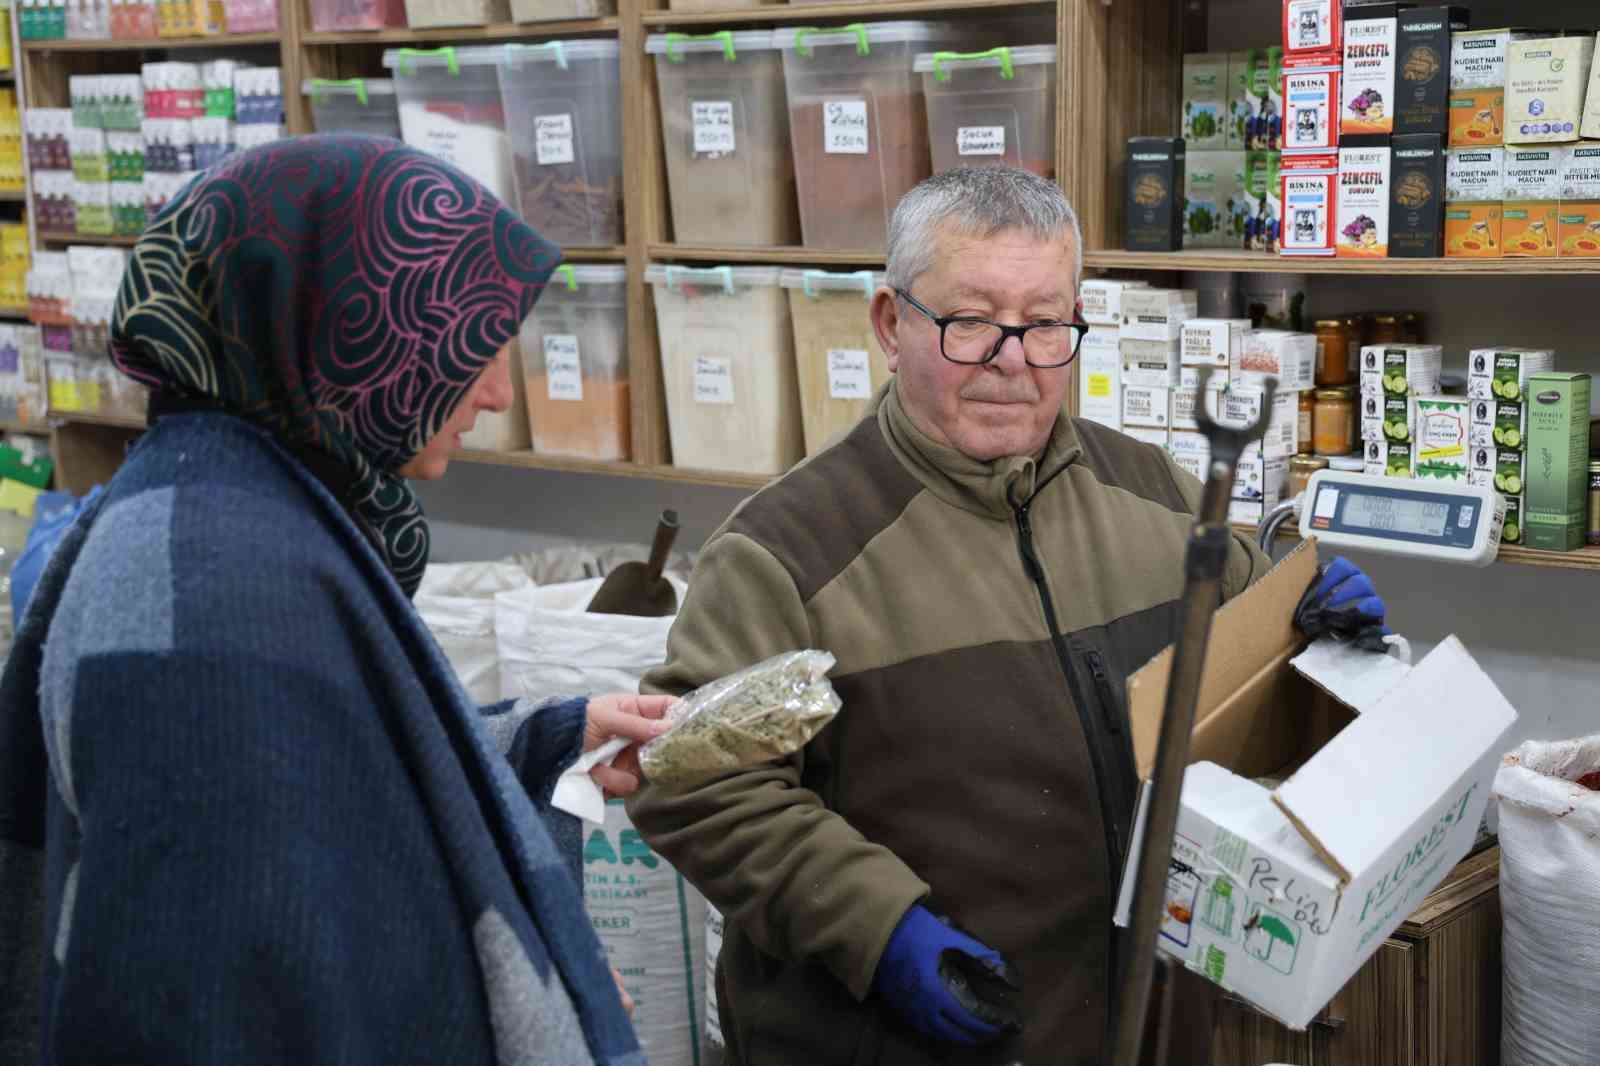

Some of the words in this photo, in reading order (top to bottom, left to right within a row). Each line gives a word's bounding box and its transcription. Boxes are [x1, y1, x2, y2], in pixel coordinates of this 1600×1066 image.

[1454, 57, 1484, 66] KUDRET
[1465, 64, 1493, 72] MACUN
[1450, 169, 1480, 178] KUDRET
[1481, 169, 1499, 177] NARI
[1507, 169, 1537, 177] KUDRET
[1538, 168, 1557, 176] NARI
[1460, 176, 1488, 184] MACUN
[1518, 176, 1545, 184] MACUN
